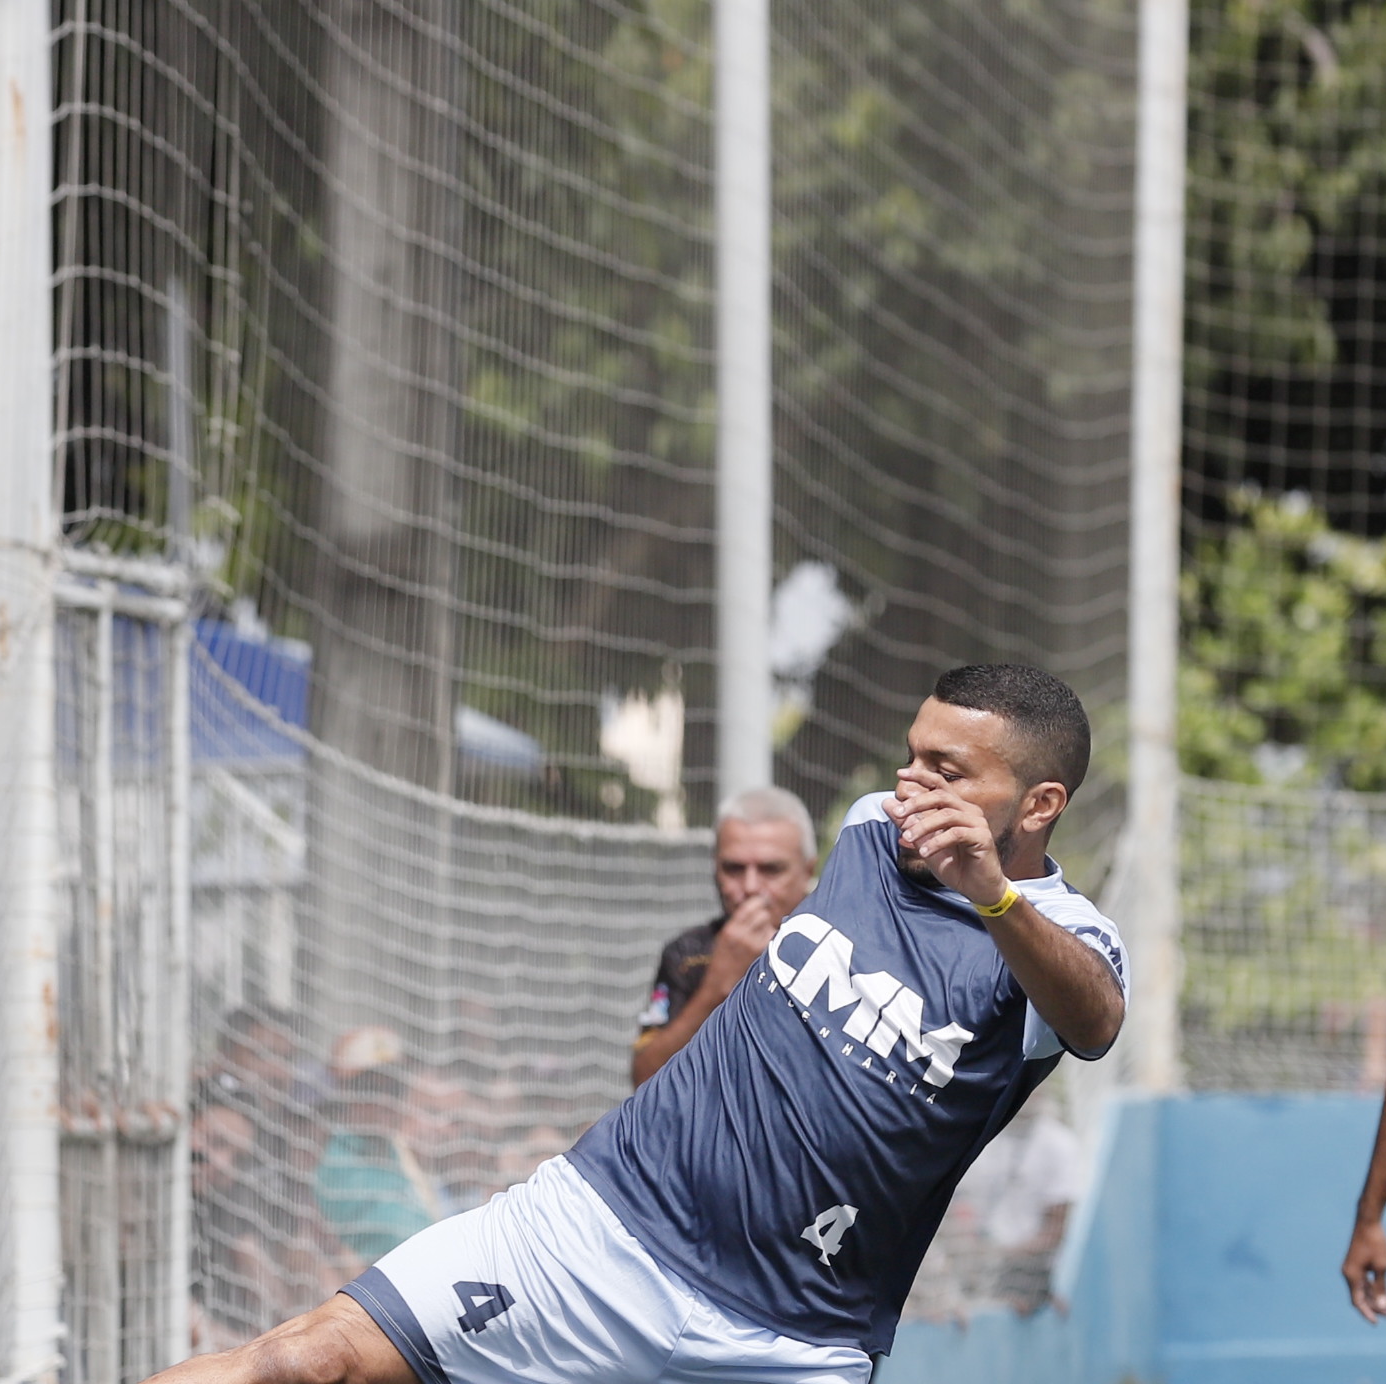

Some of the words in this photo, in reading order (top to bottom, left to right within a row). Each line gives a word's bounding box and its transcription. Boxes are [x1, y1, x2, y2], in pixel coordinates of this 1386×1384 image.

[769, 913, 975, 1088] CMM
[800, 1204, 859, 1267] 4
[452, 1281, 516, 1334] 4
